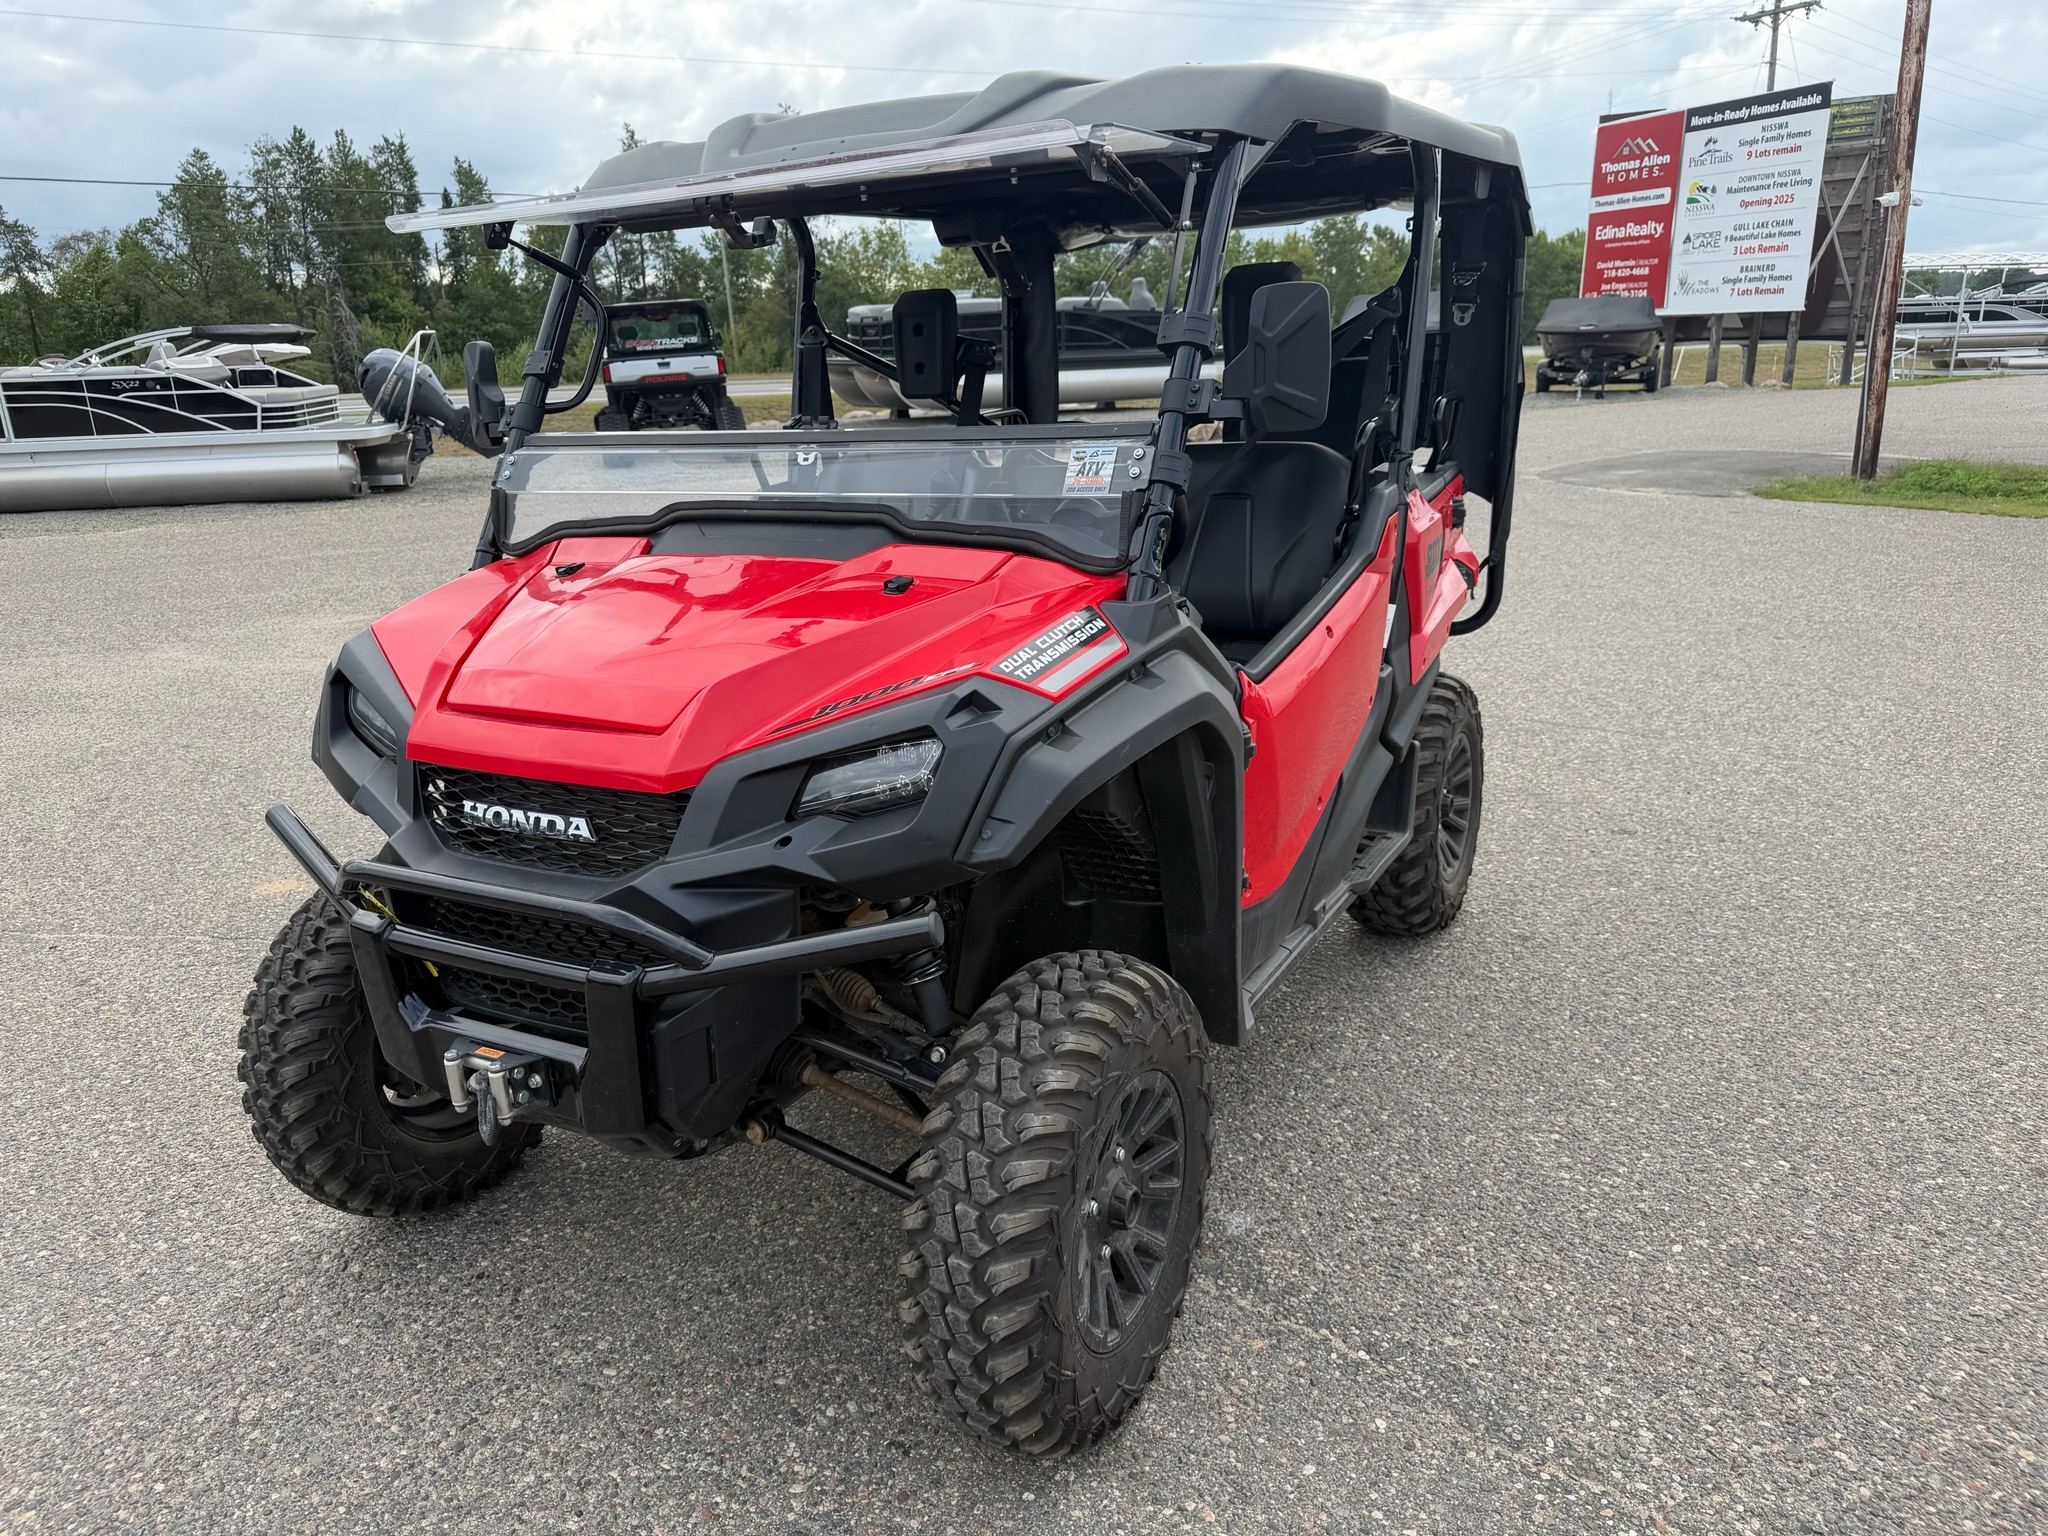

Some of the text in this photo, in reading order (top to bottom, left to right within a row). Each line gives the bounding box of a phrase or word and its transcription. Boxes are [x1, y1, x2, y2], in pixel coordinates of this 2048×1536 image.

[1690, 93, 1823, 127] Move-in-Ready Homes Available
[1761, 121, 1789, 133] NISSWA
[1738, 128, 1812, 149] Single Family Homes
[1688, 151, 1733, 168] Pine Trails
[1746, 143, 1802, 160] 9 Lots remain
[1600, 154, 1671, 174] Thomas Allen
[1606, 166, 1660, 183] HOMES
[1738, 168, 1802, 184] DOWNTOWN NISSWA
[1726, 177, 1813, 195] Maintenance Free Living
[1685, 203, 1715, 214] NISSWA
[1739, 193, 1795, 210] Opening 2025
[1733, 218, 1794, 232] GULL LAKE CHAIN
[1692, 238, 1720, 250] LAKE
[1724, 229, 1801, 243] 9 Beautiful Lake Homes
[1733, 246, 1739, 255] 3
[1739, 244, 1756, 255] Lots
[1757, 241, 1789, 254] Remain
[1596, 259, 1614, 270] David
[1739, 263, 1776, 273] BRAINERD
[1600, 283, 1611, 291] Joe
[1722, 273, 1793, 286] Single Family Homes
[1729, 285, 1784, 297] 7 Lots Remain
[645, 374, 687, 383] POLARIS
[1075, 460, 1106, 477] ATV
[998, 615, 1084, 674] DUAL CLUTCH
[1013, 617, 1108, 681] TRANSMISSION
[812, 675, 925, 719] 1000
[462, 799, 597, 844] HONDA
